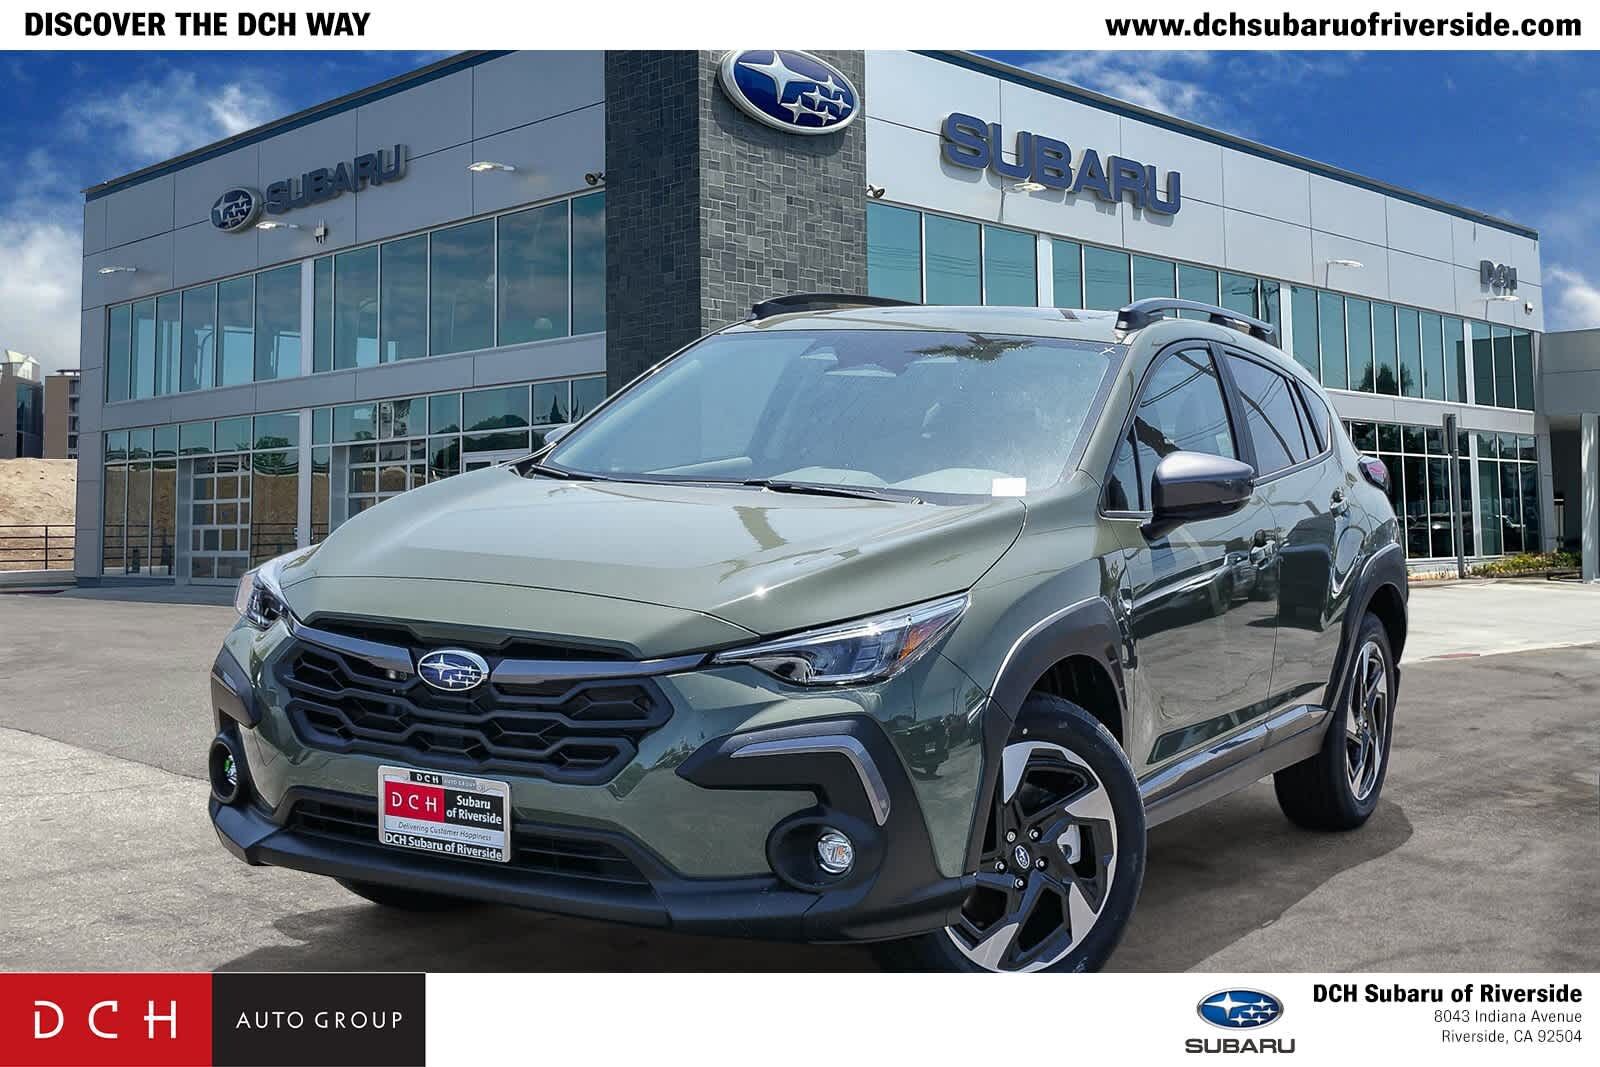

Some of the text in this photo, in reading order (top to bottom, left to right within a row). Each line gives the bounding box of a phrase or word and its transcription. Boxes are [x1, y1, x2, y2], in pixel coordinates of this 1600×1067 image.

[941, 112, 1181, 215] SUBARU
[266, 144, 406, 214] SUBARU
[416, 773, 440, 785] DCH
[391, 791, 437, 813] DCH
[456, 794, 491, 810] Subaru
[446, 808, 502, 825] of Riverside
[398, 821, 429, 834] Delivering
[460, 830, 492, 842] Happiness
[385, 832, 503, 861] DCH Subaru of Riverside
